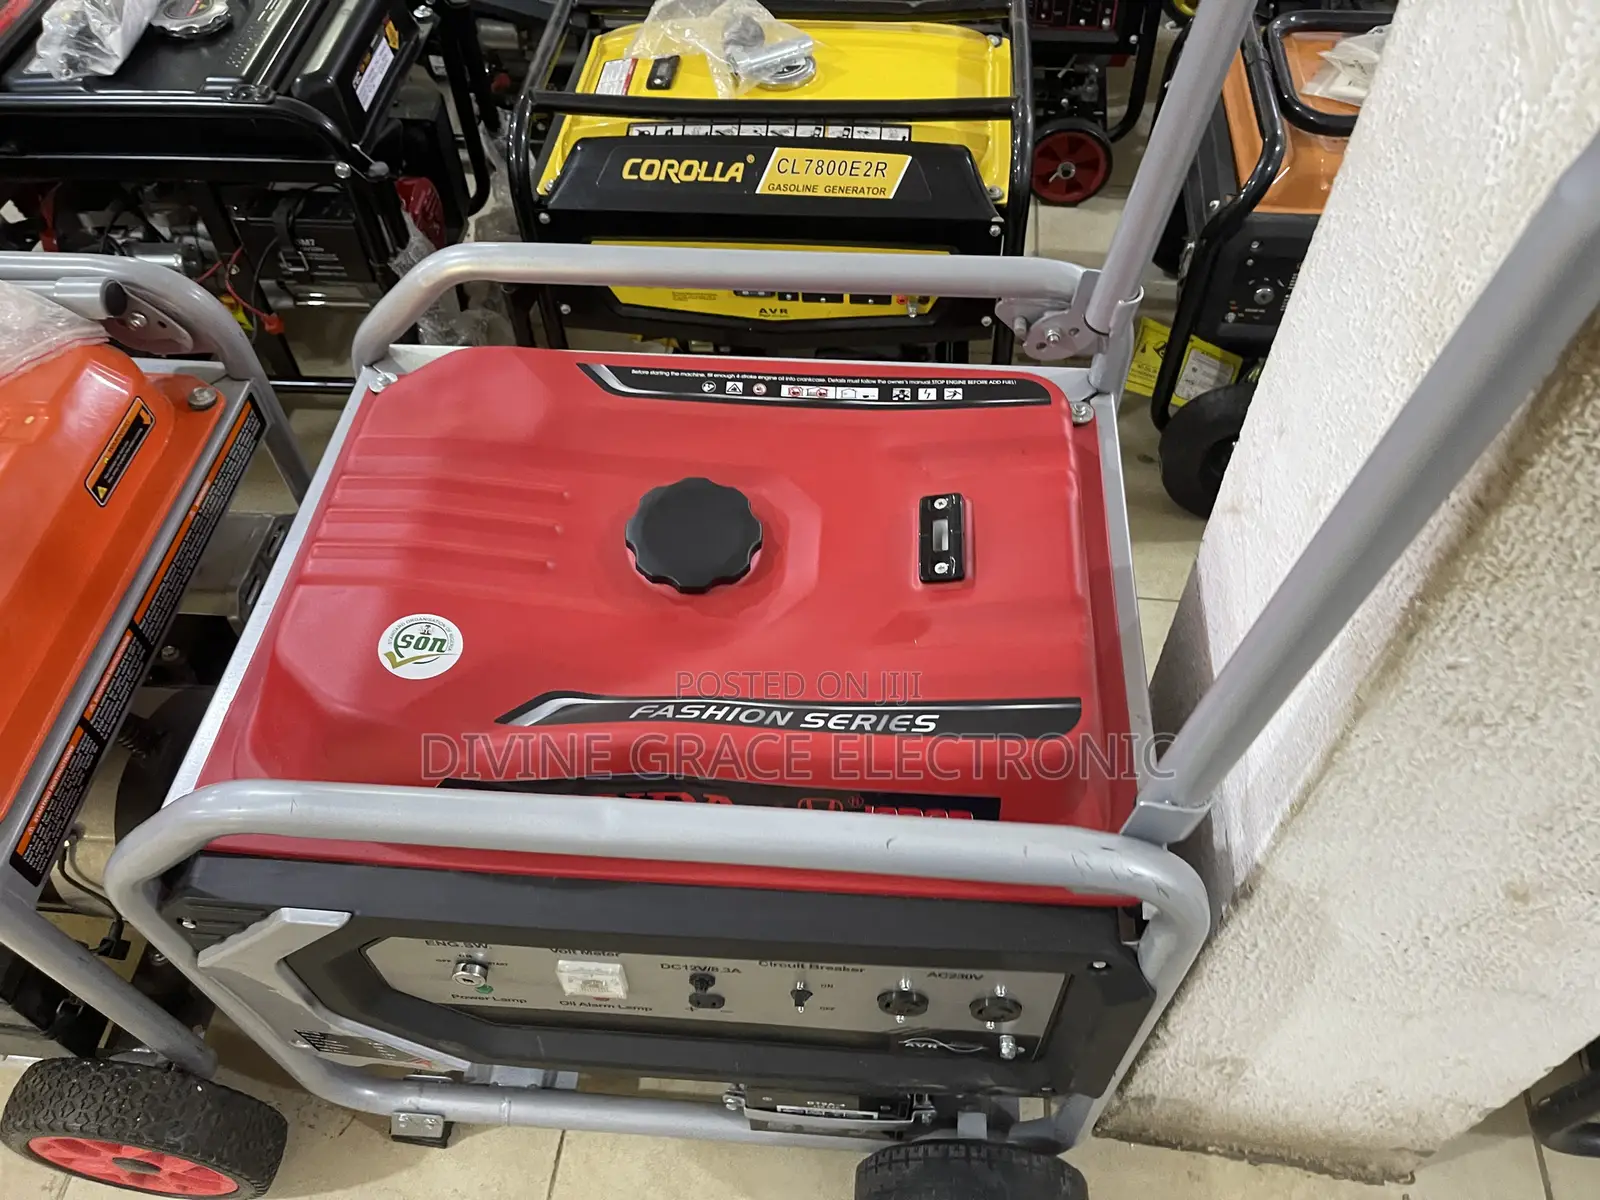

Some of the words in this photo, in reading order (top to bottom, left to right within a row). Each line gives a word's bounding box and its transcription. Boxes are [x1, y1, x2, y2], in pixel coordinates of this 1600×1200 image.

[622, 158, 745, 183] COROLLA
[777, 157, 888, 178] CL7800E2R
[768, 183, 818, 193] GASOLINE
[824, 185, 886, 196] GENERATOR
[650, 370, 670, 378] starting
[629, 704, 794, 726] FASHION
[800, 712, 940, 733] SERIES
[758, 960, 806, 969] Circuit
[809, 963, 866, 973] Breaker
[926, 971, 984, 980] AC230V
[451, 993, 490, 1001] Power
[491, 996, 528, 1004] Lamp
[559, 1000, 577, 1008] Oil
[618, 1004, 654, 1012] Lamp
